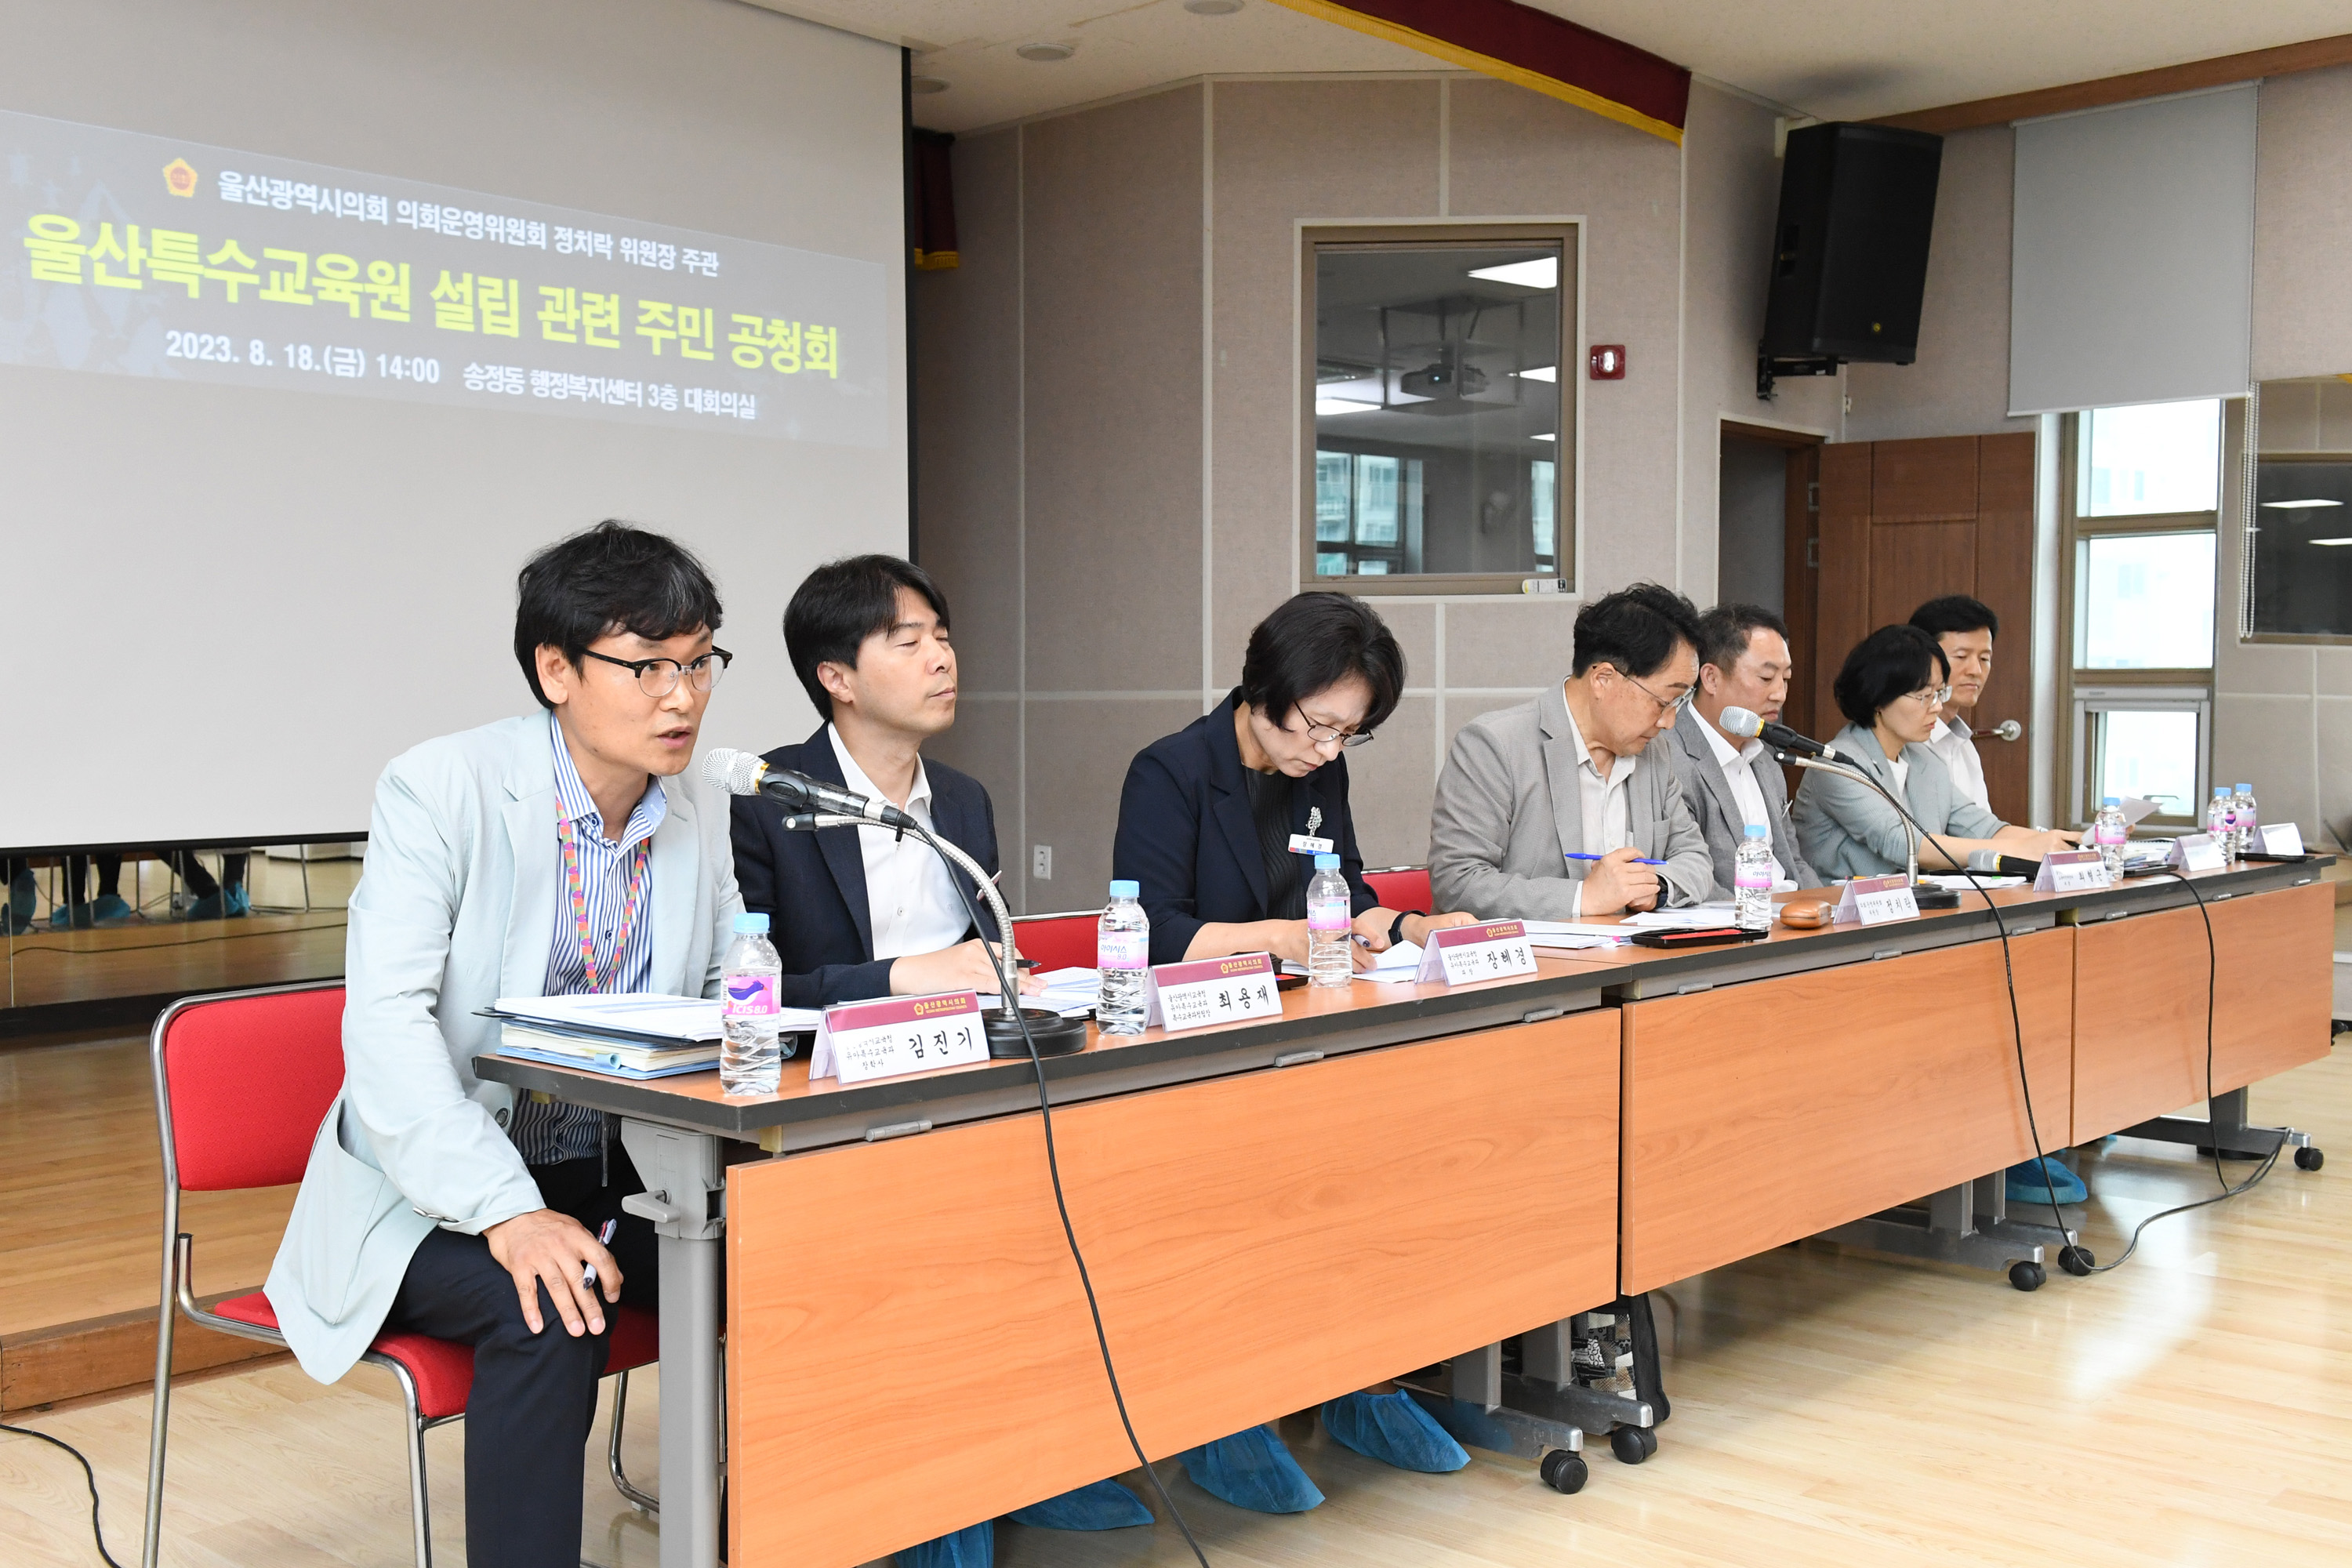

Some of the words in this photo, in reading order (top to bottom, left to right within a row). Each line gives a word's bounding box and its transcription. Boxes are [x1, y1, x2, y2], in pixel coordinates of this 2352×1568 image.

[217, 169, 389, 226] 울산광역시의회
[395, 198, 547, 249] 의회운영위원회
[554, 224, 613, 261] 정치락
[619, 234, 676, 272] 위원장
[682, 247, 719, 277] 주관
[24, 213, 412, 323] 울산특수교육원
[430, 270, 520, 339] 설립
[538, 284, 621, 350] 관련
[635, 298, 715, 362] 주민
[728, 313, 839, 379] 공청회
[165, 330, 240, 365] 2023.
[249, 339, 274, 367] 8.
[284, 343, 366, 379] 18.(금)
[376, 353, 440, 384] 14:00
[463, 361, 525, 396] 송정동
[529, 368, 644, 408] 행정복지센터
[648, 383, 679, 412] 3층
[684, 387, 757, 420] 대회의실
[753, 1004, 768, 1014] 8.0
[1218, 985, 1270, 1012] 최용재
[846, 1045, 895, 1061] 유아특수교육과
[909, 1026, 974, 1060] 김진기
